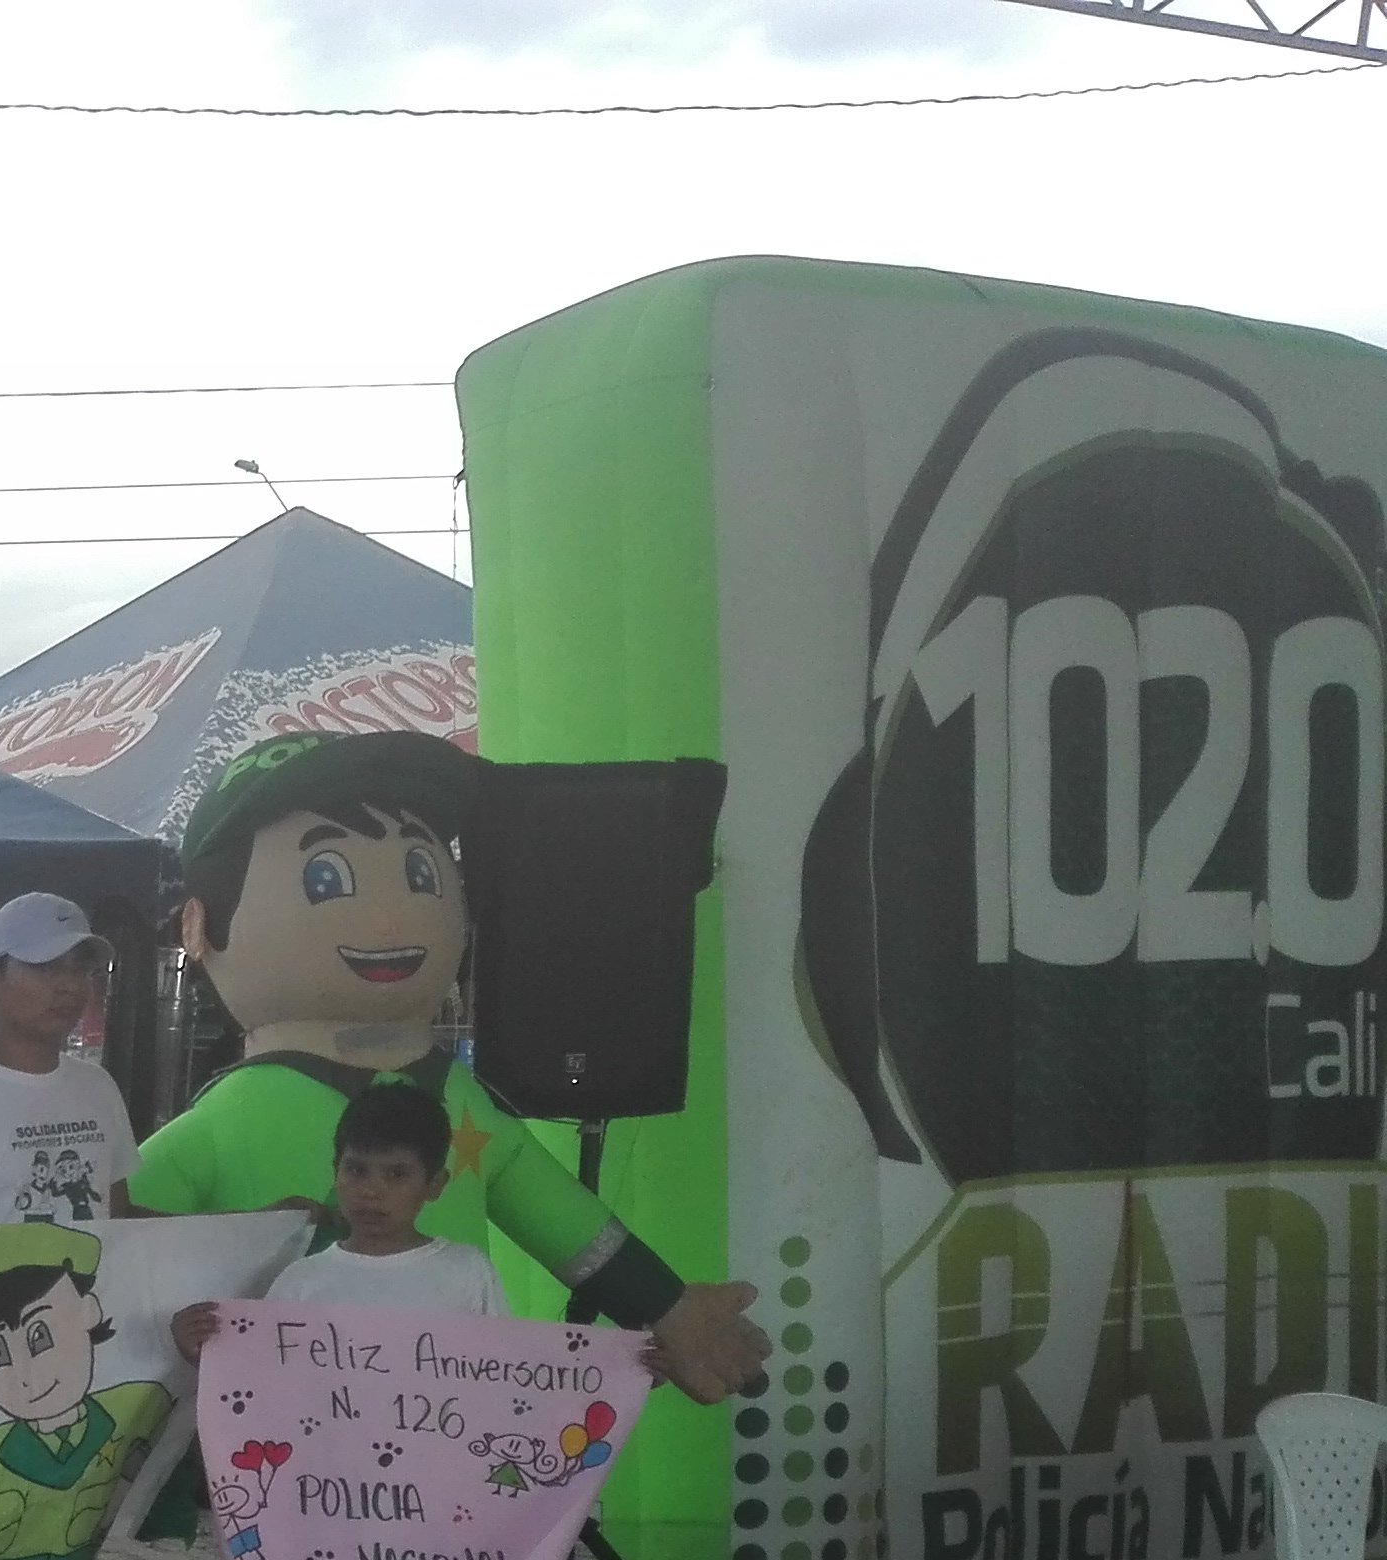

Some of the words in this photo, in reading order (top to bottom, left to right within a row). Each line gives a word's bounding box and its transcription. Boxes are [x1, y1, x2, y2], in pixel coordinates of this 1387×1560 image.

[1266, 991, 1377, 1098] Cali
[16, 1120, 97, 1138] SOLIDARIDAD
[276, 1322, 390, 1374] Feliz
[414, 1332, 603, 1394] Aniversario
[393, 1394, 466, 1439] 126
[296, 1475, 426, 1522] POLICIA
